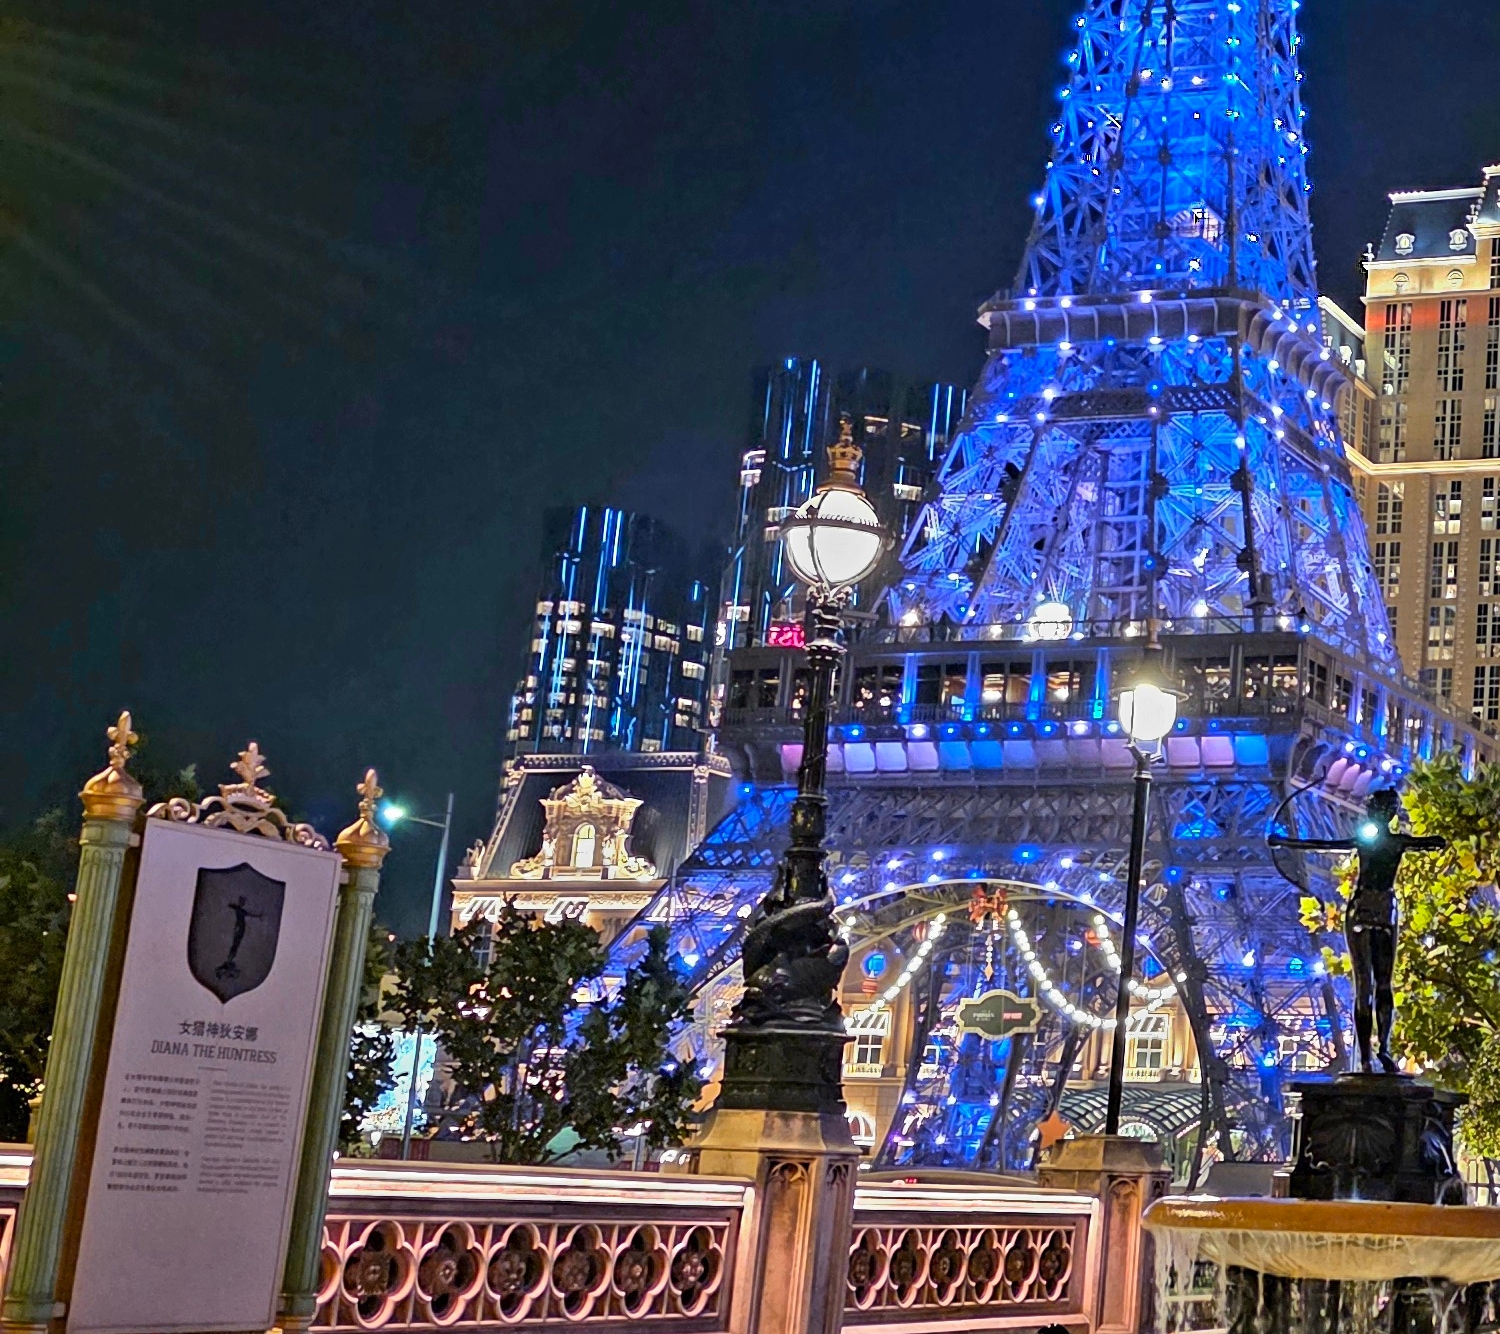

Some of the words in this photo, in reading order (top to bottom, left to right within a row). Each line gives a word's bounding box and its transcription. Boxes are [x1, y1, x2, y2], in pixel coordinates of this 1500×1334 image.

[150, 1039, 190, 1056] DIANA
[192, 1043, 216, 1059] THE
[216, 1046, 278, 1064] HUNTRESS
